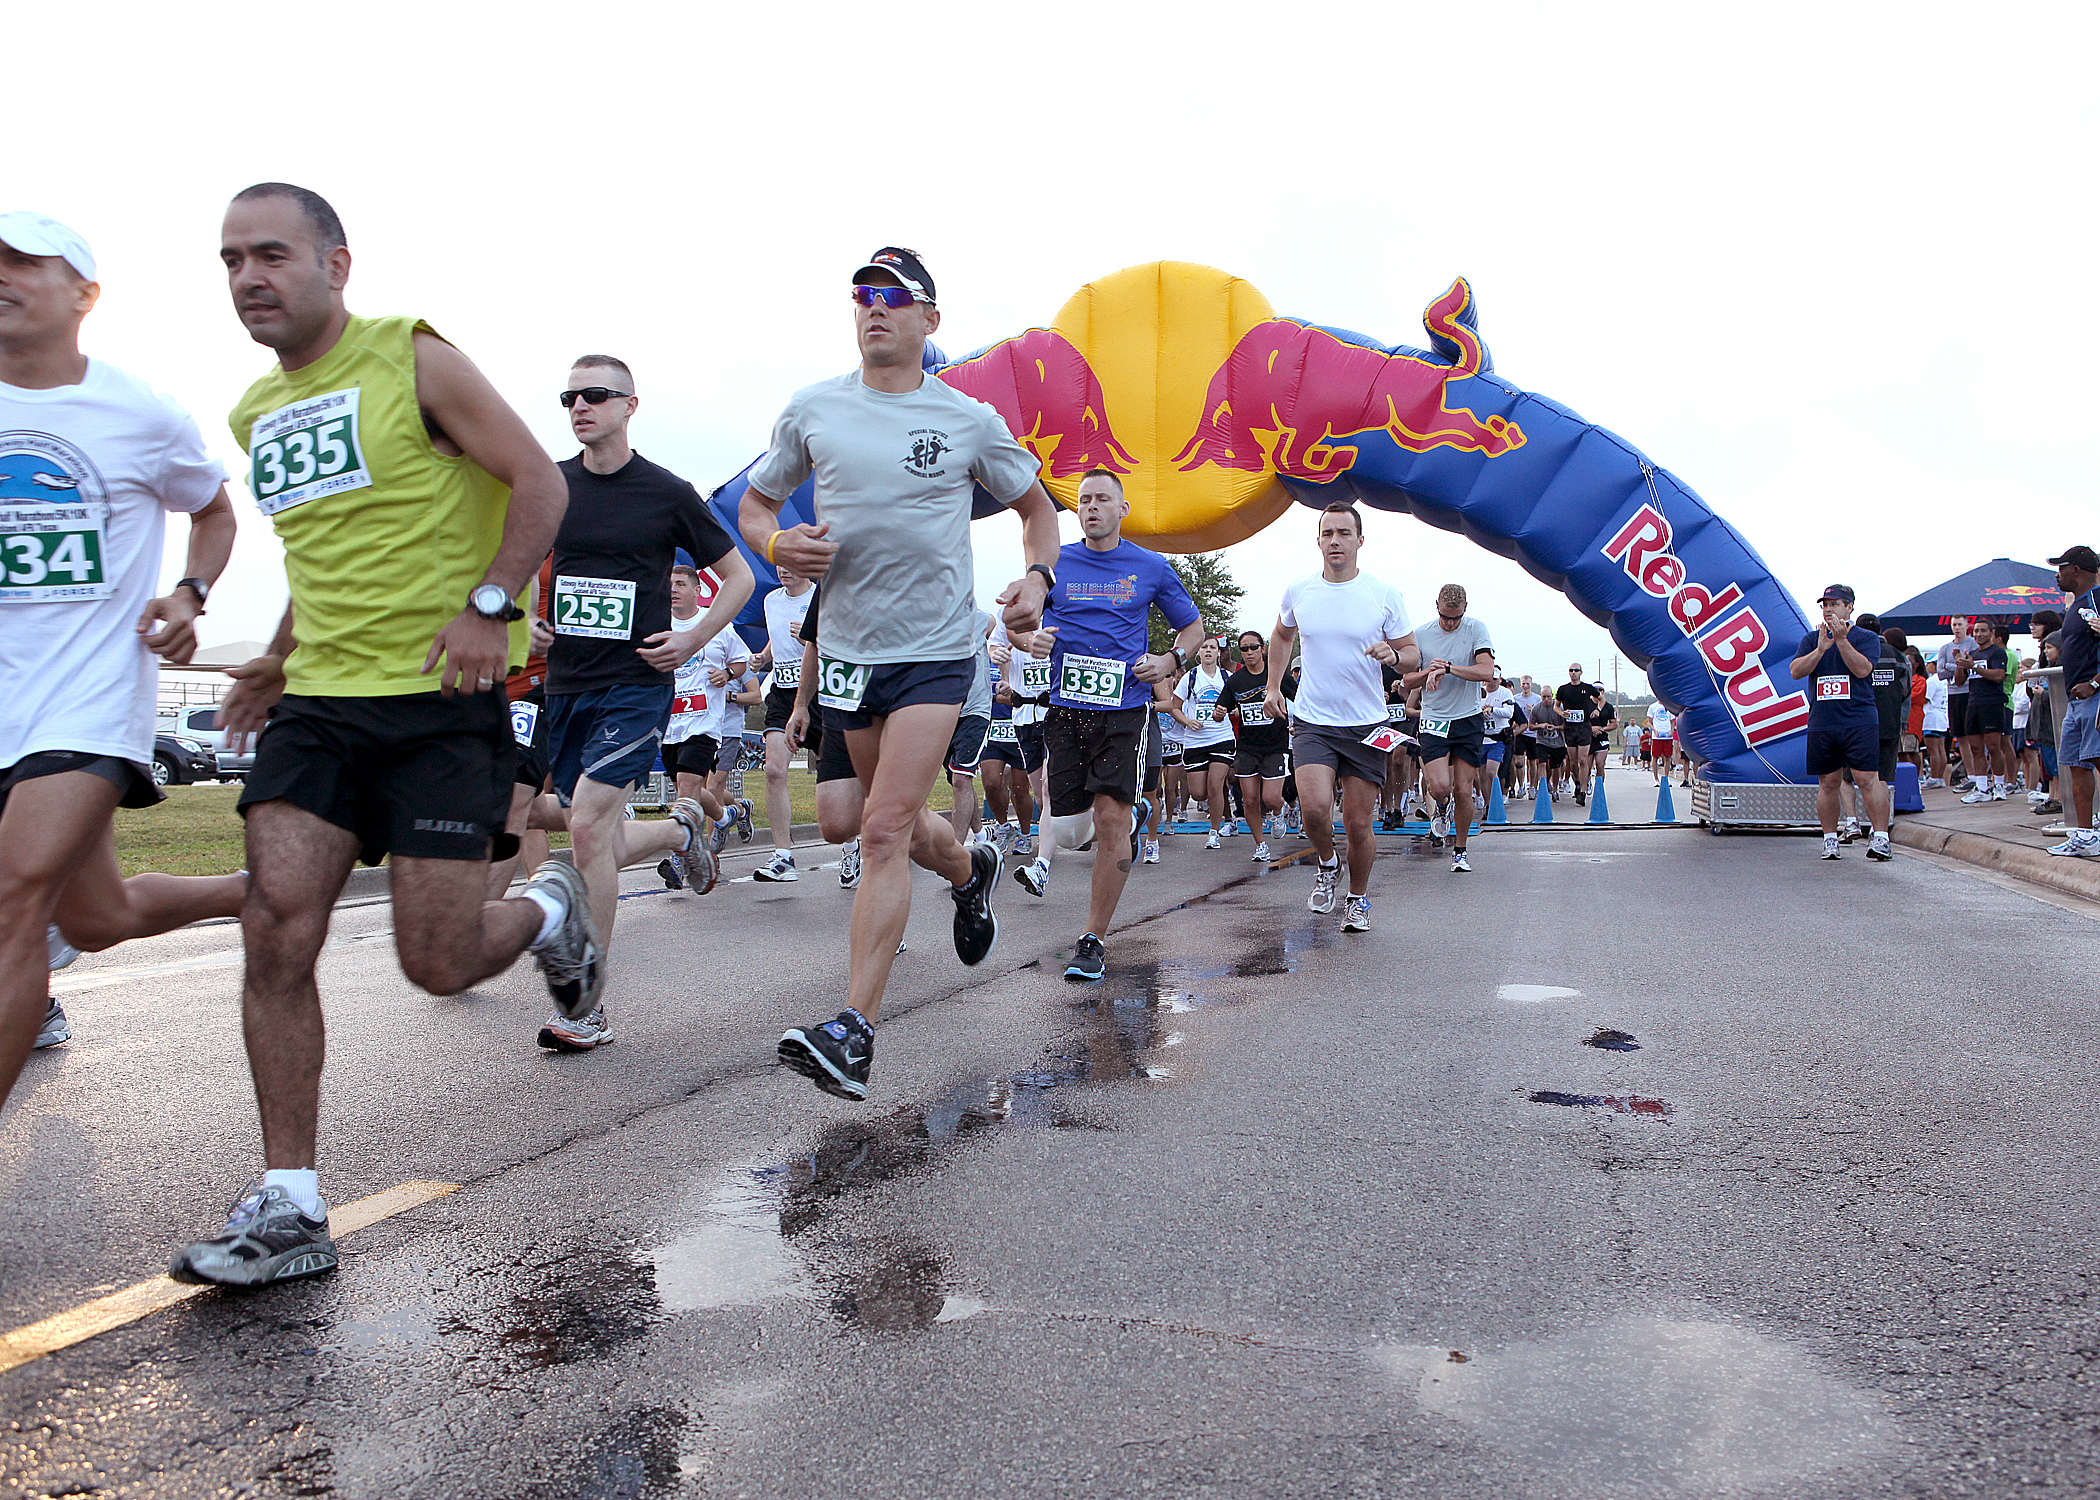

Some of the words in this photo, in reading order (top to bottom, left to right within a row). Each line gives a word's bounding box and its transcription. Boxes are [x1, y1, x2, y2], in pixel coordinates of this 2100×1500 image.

[929, 429, 948, 439] TACTICS
[257, 420, 349, 494] 335
[1981, 597, 2026, 605] Red
[2029, 596, 2066, 605] Bul
[561, 595, 624, 628] 253
[1600, 502, 1746, 639] Red
[1692, 605, 1811, 748] Bull
[1066, 669, 1117, 696] 339
[1823, 682, 1842, 695] 89
[682, 697, 694, 711] 2
[993, 727, 1016, 738] 298
[1162, 743, 1178, 753] 29
